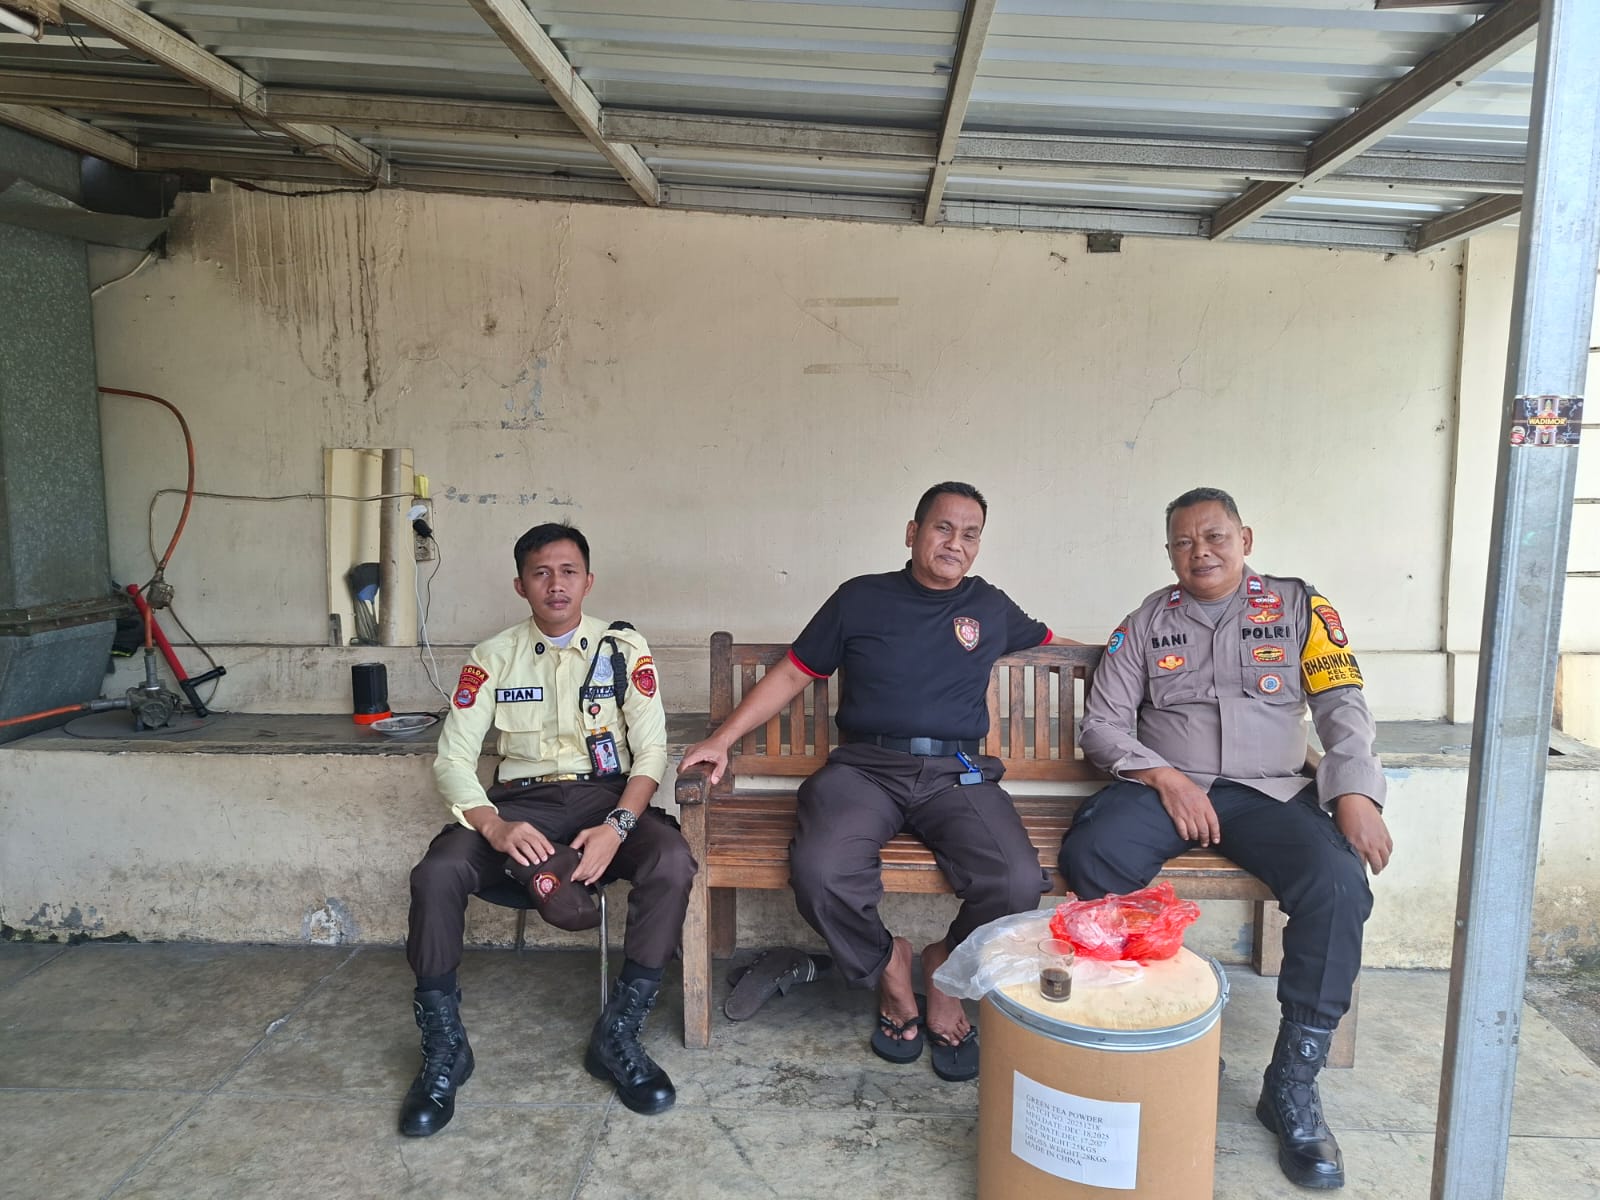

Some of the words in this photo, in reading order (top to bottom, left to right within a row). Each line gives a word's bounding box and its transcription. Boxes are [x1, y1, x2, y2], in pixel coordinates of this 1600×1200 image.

[1529, 417, 1567, 425] WADIMOR
[1242, 626, 1290, 640] POLRI
[1151, 633, 1187, 649] BANI
[1304, 652, 1356, 676] BHABINKA
[464, 667, 485, 679] POLDA
[503, 690, 534, 700] PIAN
[1026, 1094, 1049, 1109] GREEN
[1052, 1106, 1066, 1115] TEA
[1069, 1111, 1103, 1123] POWDER
[1026, 1102, 1049, 1117] BATCH
[1025, 1132, 1047, 1147] GROSS
[1025, 1140, 1044, 1153] MADE
[1046, 1149, 1054, 1158] IN
[1057, 1154, 1082, 1165] CHINA
